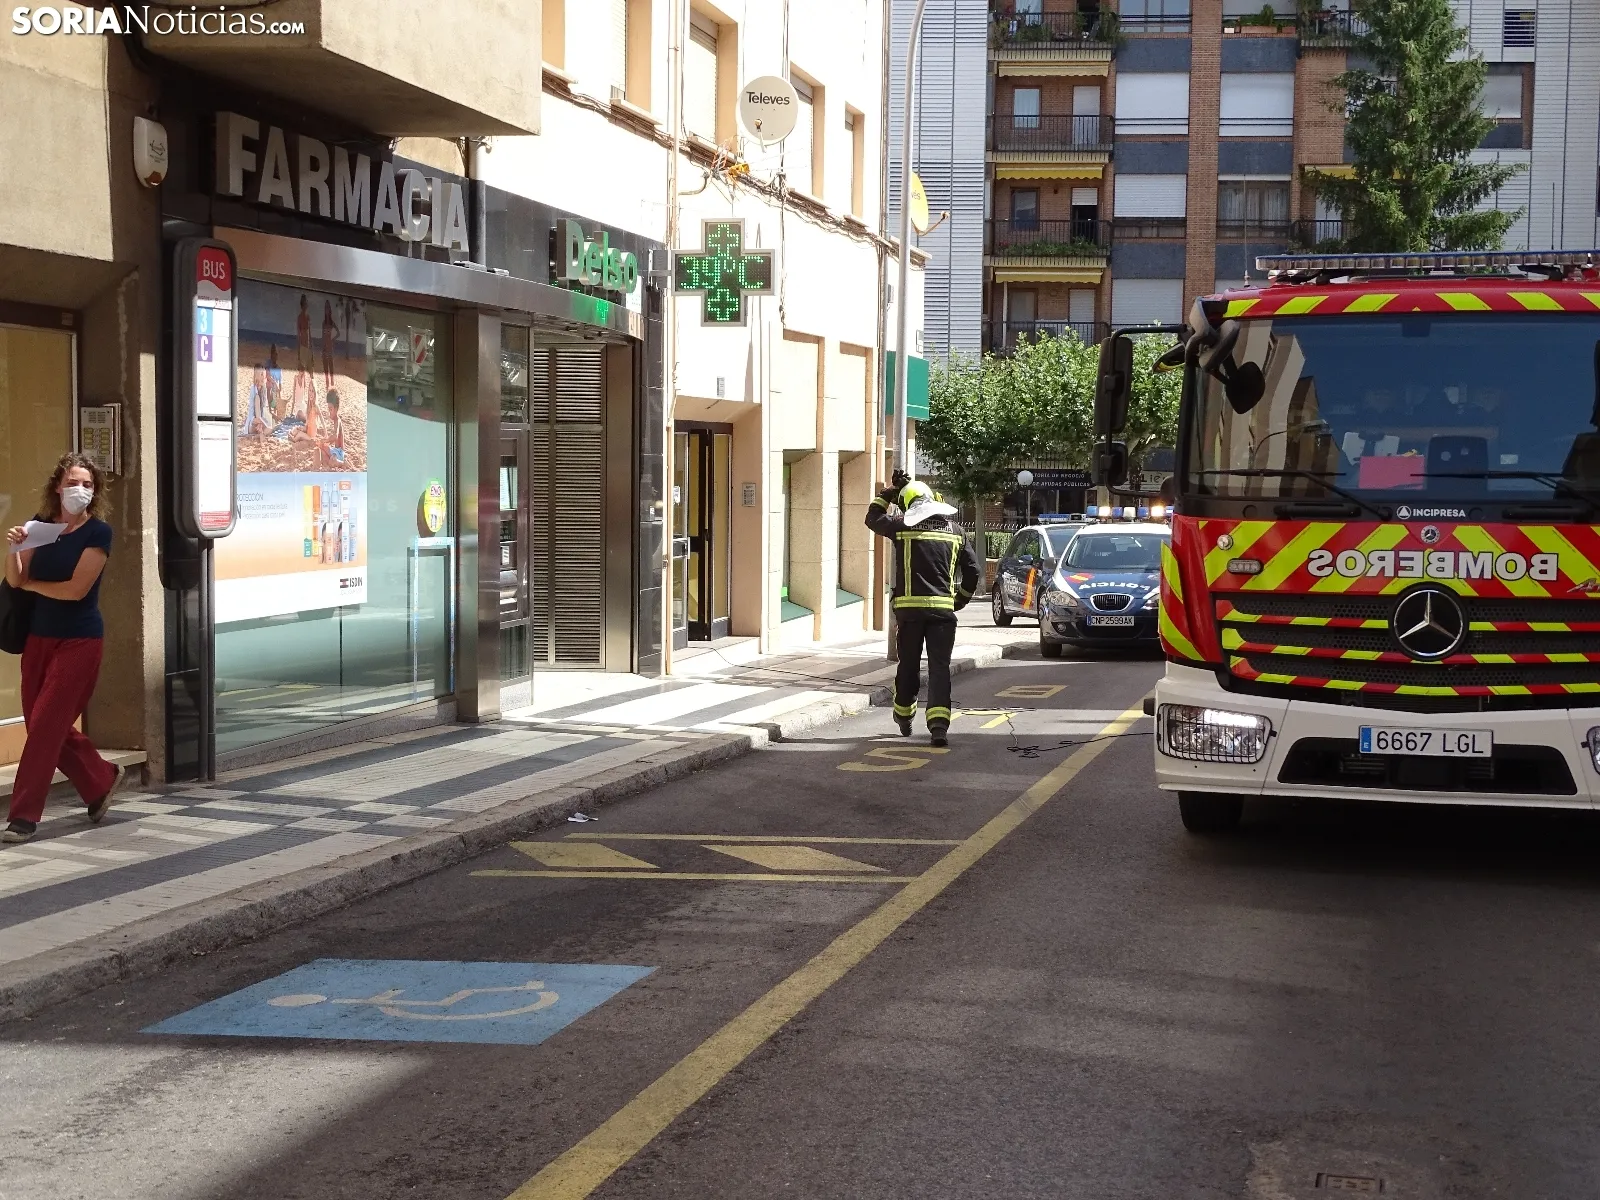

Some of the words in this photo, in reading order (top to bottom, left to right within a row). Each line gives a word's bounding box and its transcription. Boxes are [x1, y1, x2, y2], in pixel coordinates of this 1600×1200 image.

[746, 91, 790, 105] Televes
[216, 111, 470, 252] FARMACIA
[557, 218, 638, 294] Delso
[203, 259, 226, 280] BUS
[200, 308, 208, 333] 3
[200, 335, 209, 361] C
[1412, 508, 1466, 518] INCIPRESA
[1376, 730, 1432, 752] 6667
[1442, 732, 1484, 754] LGL
